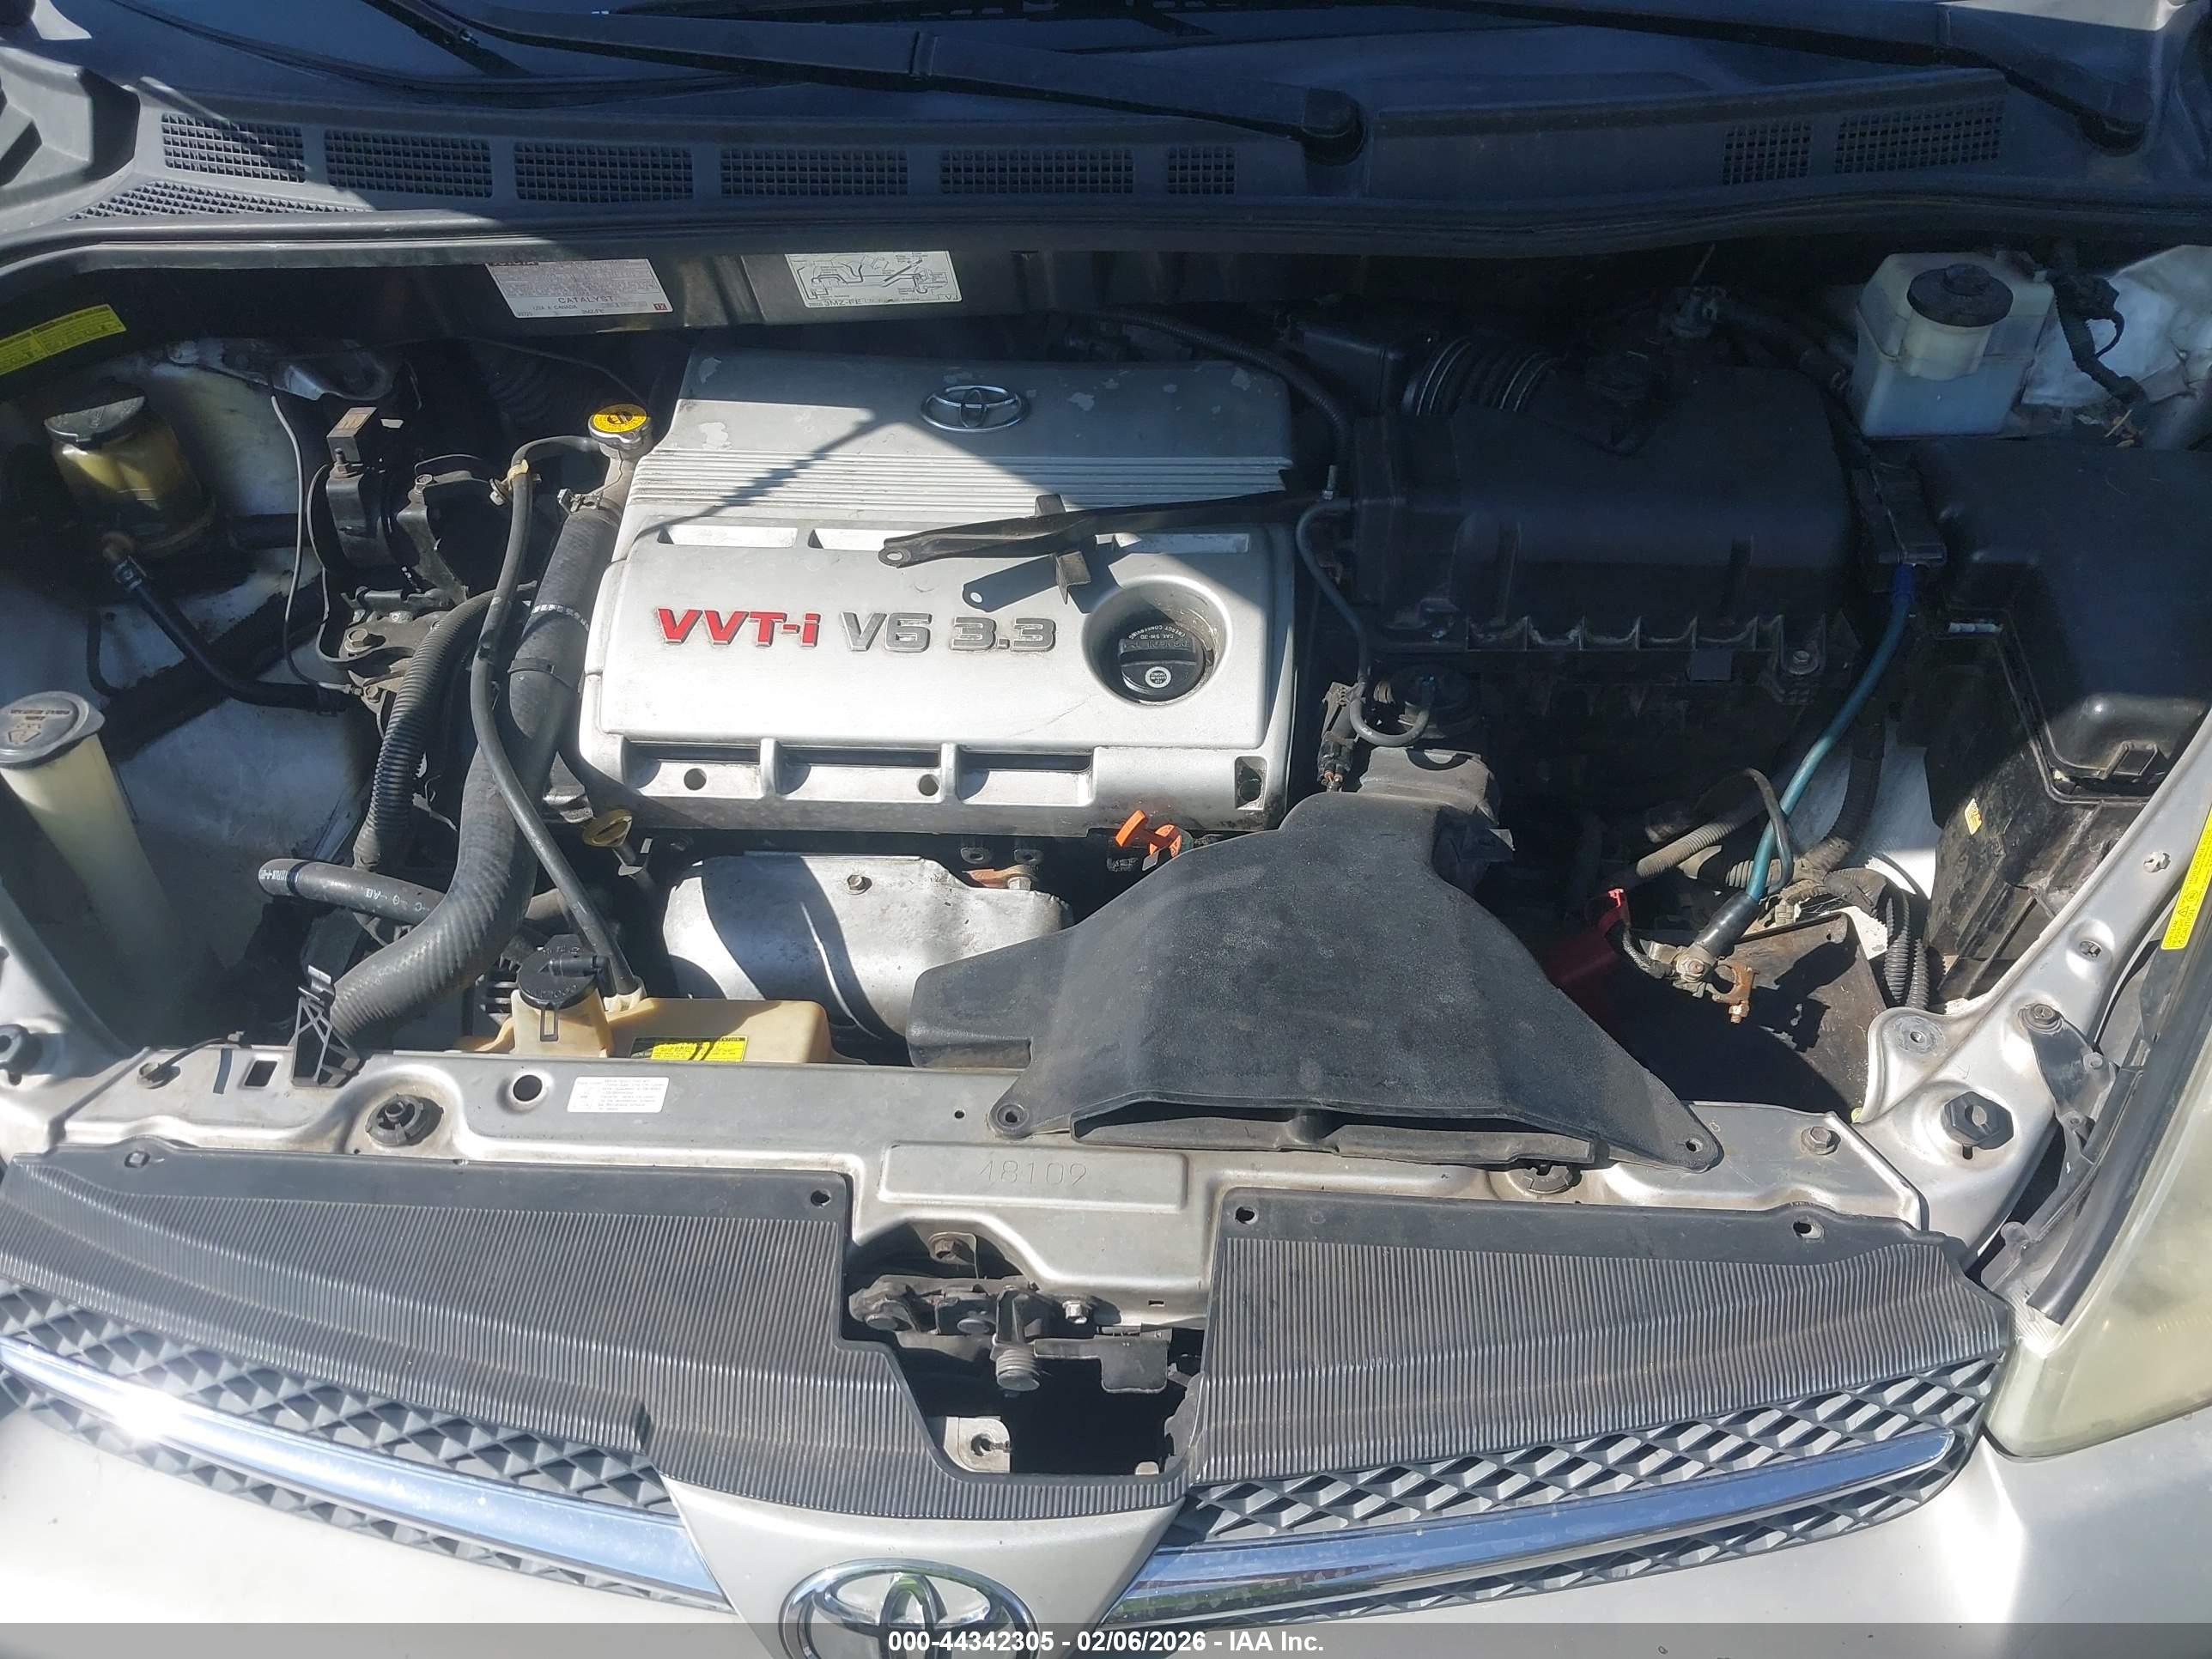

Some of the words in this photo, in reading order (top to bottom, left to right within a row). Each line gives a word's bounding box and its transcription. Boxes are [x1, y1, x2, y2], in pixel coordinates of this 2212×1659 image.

[558, 295, 613, 304] CATALYST
[657, 607, 822, 648] VVT-i
[838, 611, 933, 653] V6
[949, 615, 1057, 653] 3.3
